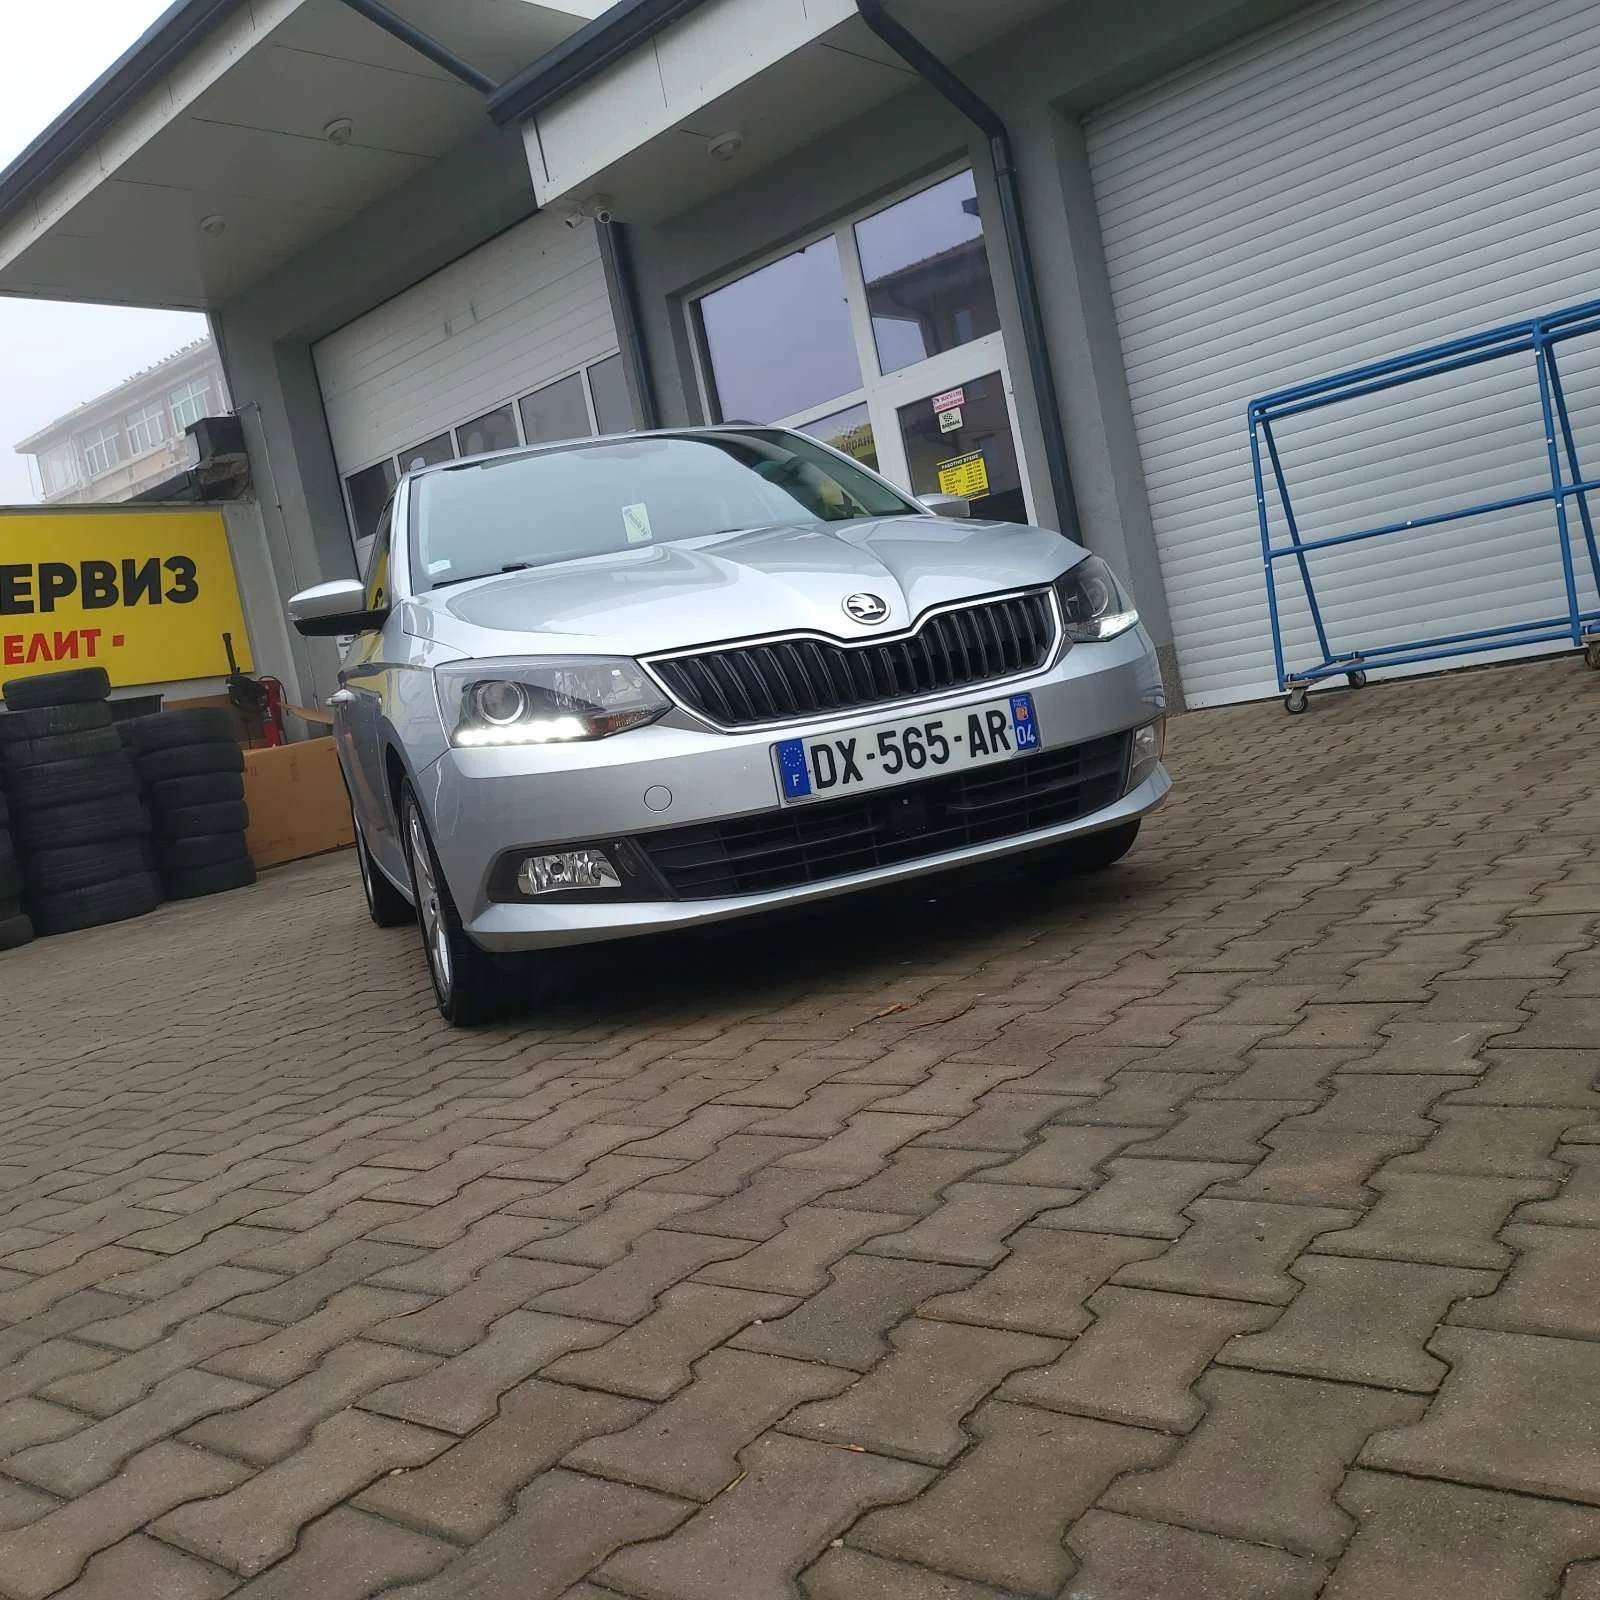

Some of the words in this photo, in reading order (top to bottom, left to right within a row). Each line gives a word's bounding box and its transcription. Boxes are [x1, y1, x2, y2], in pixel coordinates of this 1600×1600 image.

[0, 555, 199, 615] ЕРВИЗ
[4, 628, 102, 665] ЕЛИТ
[1016, 724, 1036, 745] 04
[792, 773, 800, 787] F
